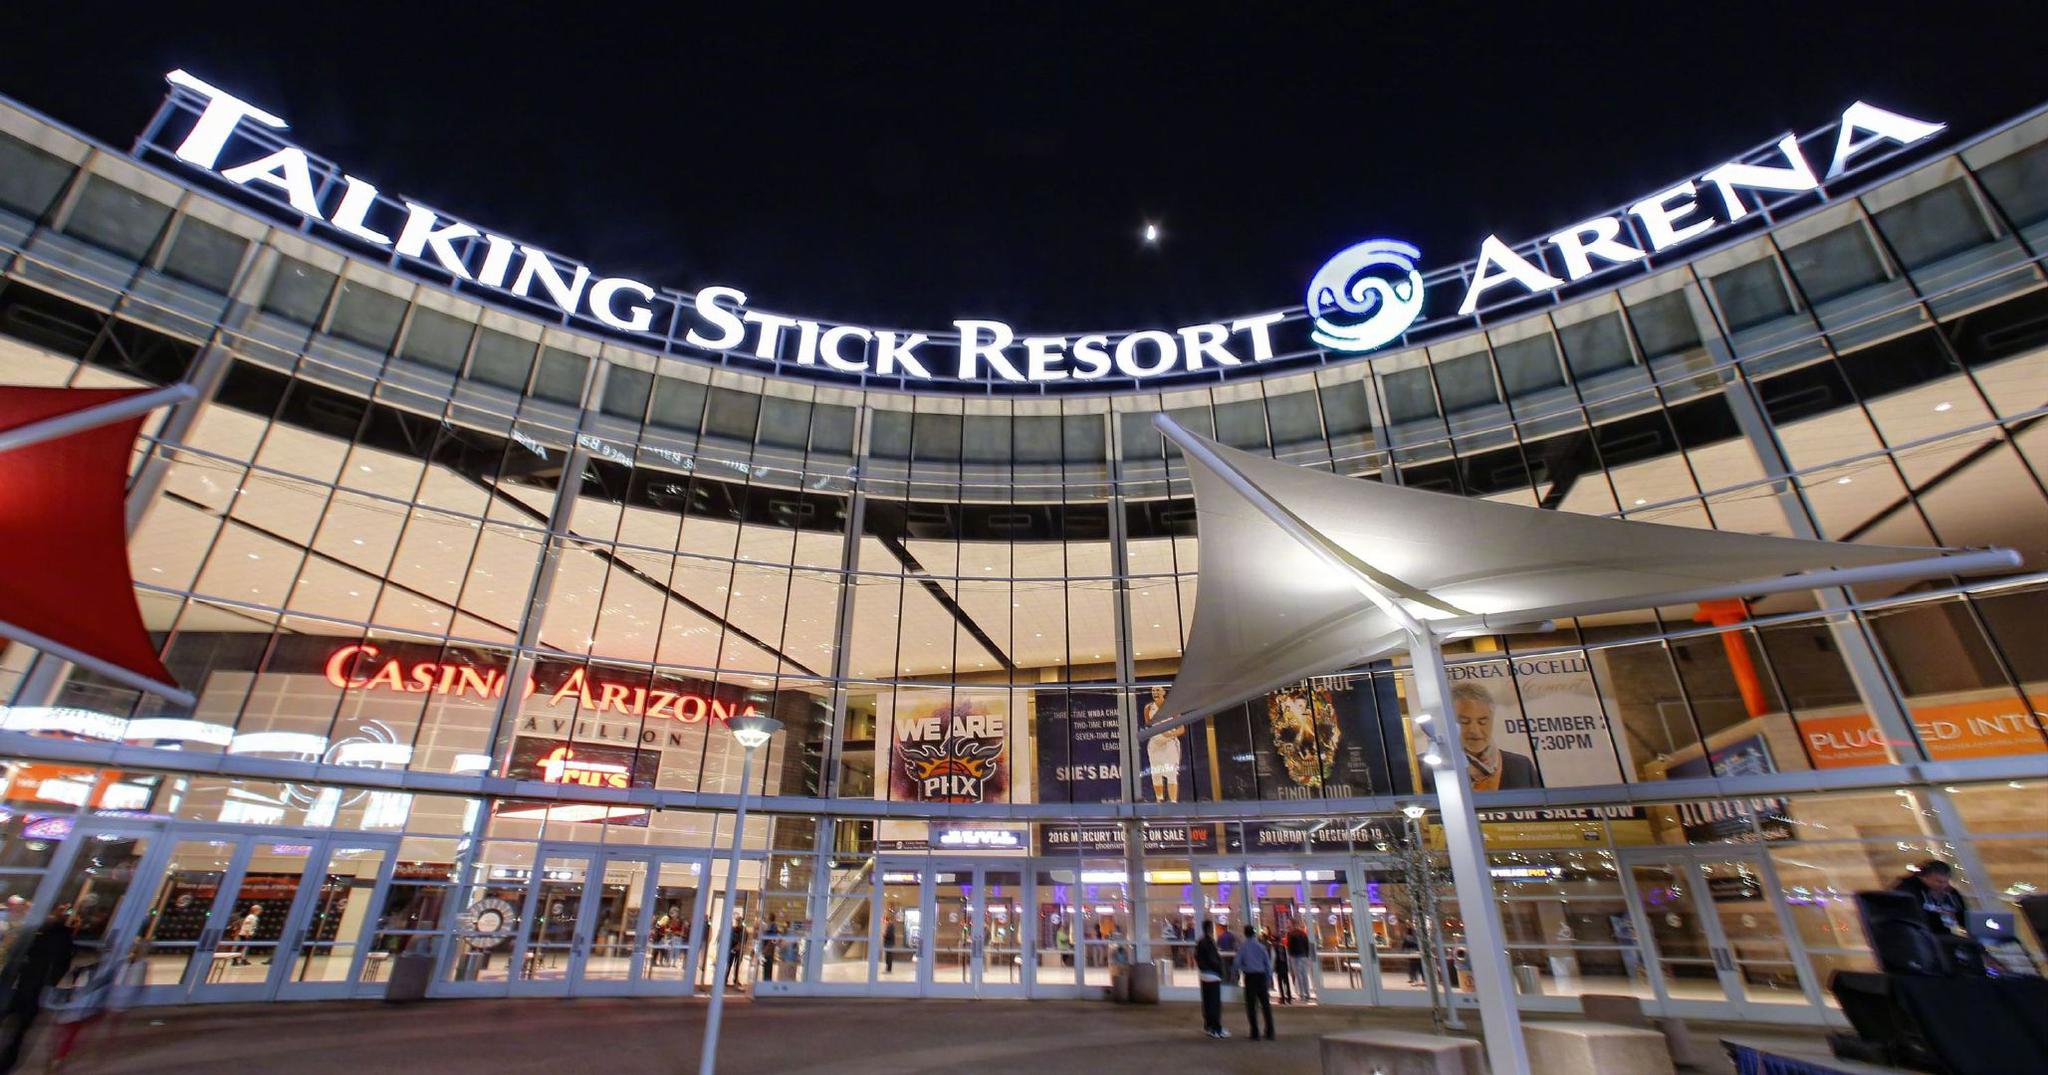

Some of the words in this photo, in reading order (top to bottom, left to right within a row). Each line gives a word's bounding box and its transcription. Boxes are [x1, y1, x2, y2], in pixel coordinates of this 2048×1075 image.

[165, 67, 656, 332] TALKING
[686, 286, 932, 379] STICK
[953, 312, 1285, 383] RESORT
[1458, 100, 1947, 316] ARENA
[524, 717, 682, 746] AVILION
[894, 716, 942, 742] WE
[944, 714, 1005, 741] ARE
[1504, 715, 1598, 734] DECEMBER
[1531, 733, 1593, 751] 7:30PM
[1056, 765, 1098, 781] SHE'S
[923, 775, 978, 798] PHX
[1543, 806, 1584, 819] SALE
[1048, 832, 1069, 843] 2016
[1070, 831, 1111, 842] MRCURY
[1148, 829, 1161, 841] ON
[1162, 828, 1187, 841] SALE
[1189, 828, 1209, 841] OW
[1259, 829, 1307, 844] SATURDAY
[1319, 828, 1369, 842] DECEMBER
